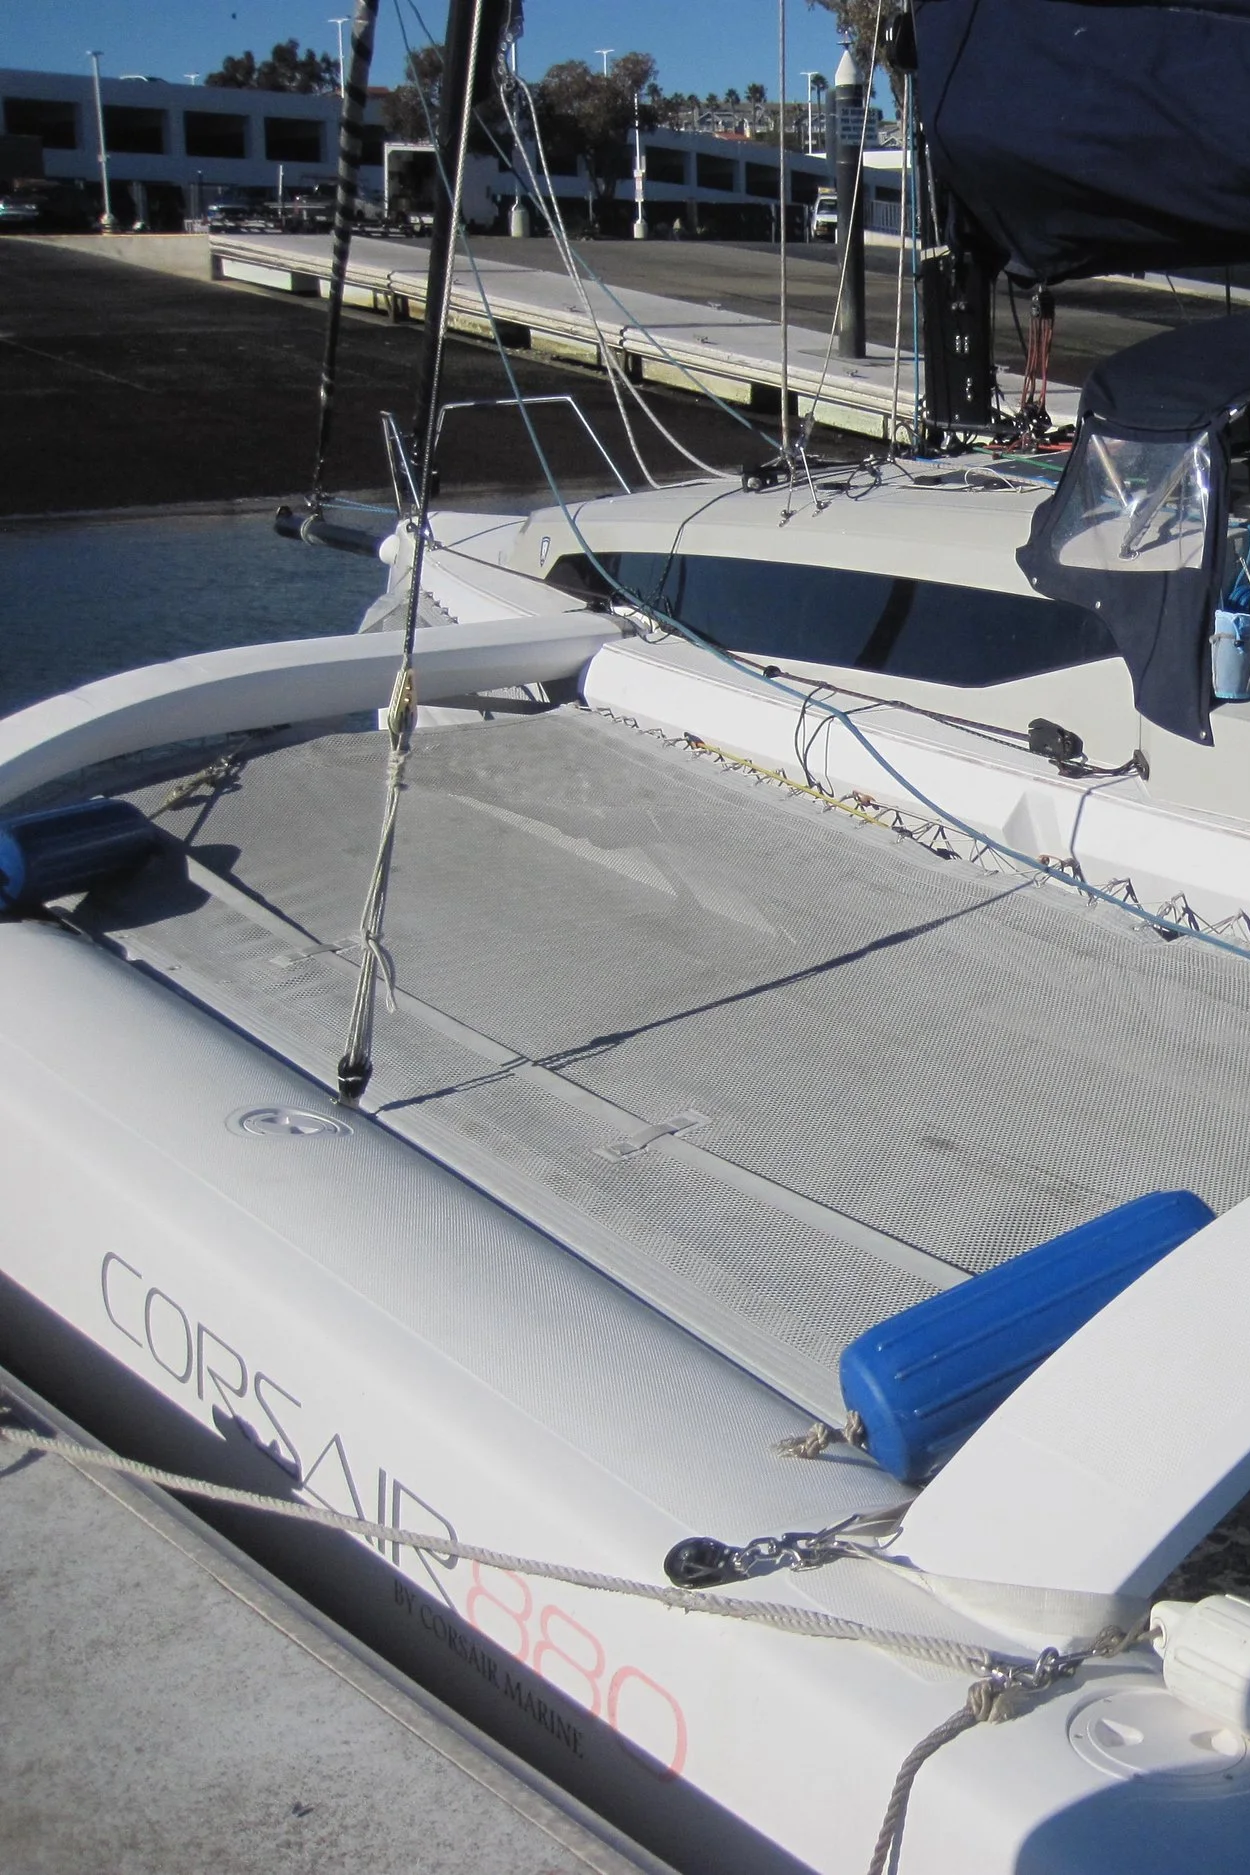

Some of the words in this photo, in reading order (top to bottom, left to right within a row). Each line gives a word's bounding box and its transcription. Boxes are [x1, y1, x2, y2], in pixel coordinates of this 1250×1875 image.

[101, 1251, 462, 1619] CORSAIR
[466, 1556, 688, 1784] 880
[393, 1578, 418, 1615] BY
[419, 1603, 501, 1690] CORSAIR
[503, 1672, 585, 1760] MARINE
